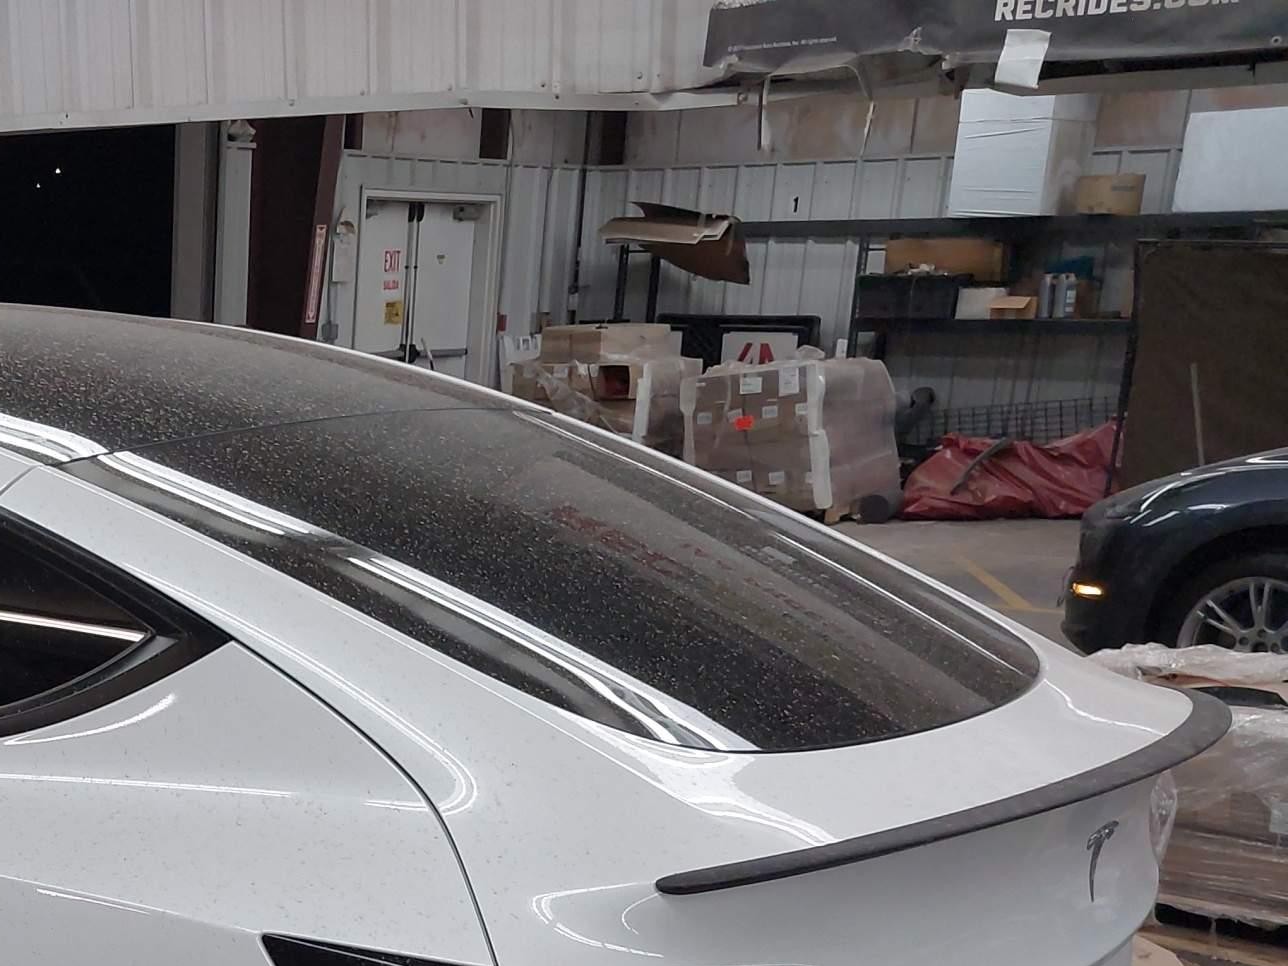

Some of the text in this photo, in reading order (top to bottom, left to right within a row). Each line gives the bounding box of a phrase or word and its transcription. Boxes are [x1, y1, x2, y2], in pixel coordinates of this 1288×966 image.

[993, 0, 1240, 21] RECRIDES.
[793, 196, 800, 213] 1
[383, 250, 401, 273] EXIT
